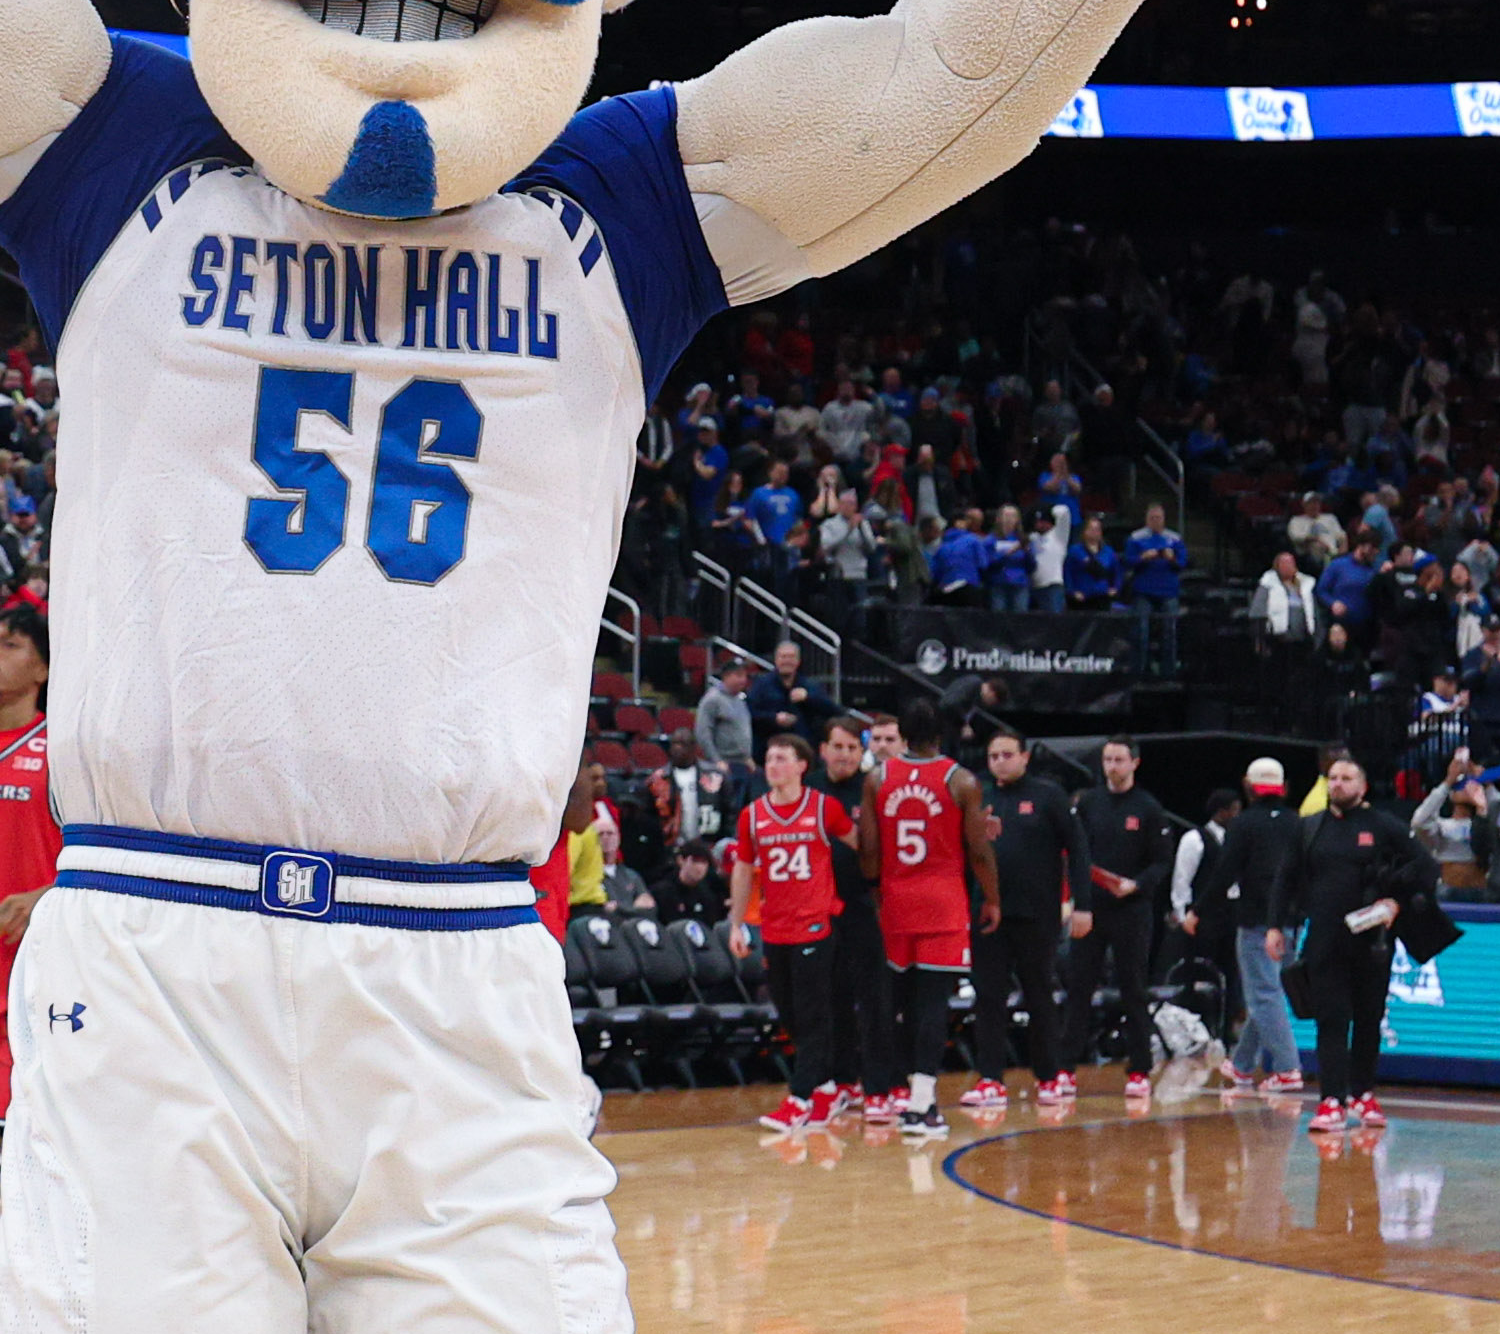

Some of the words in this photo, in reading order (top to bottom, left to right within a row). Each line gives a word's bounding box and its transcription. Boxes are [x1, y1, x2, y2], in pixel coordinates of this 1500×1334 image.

[180, 233, 385, 345] SETON
[400, 245, 559, 361] HALL
[241, 364, 485, 586] 56
[1053, 650, 1114, 674] Center
[27, 736, 48, 753] C
[768, 845, 812, 883] 24
[897, 819, 927, 866] 5
[277, 860, 318, 907] SH
